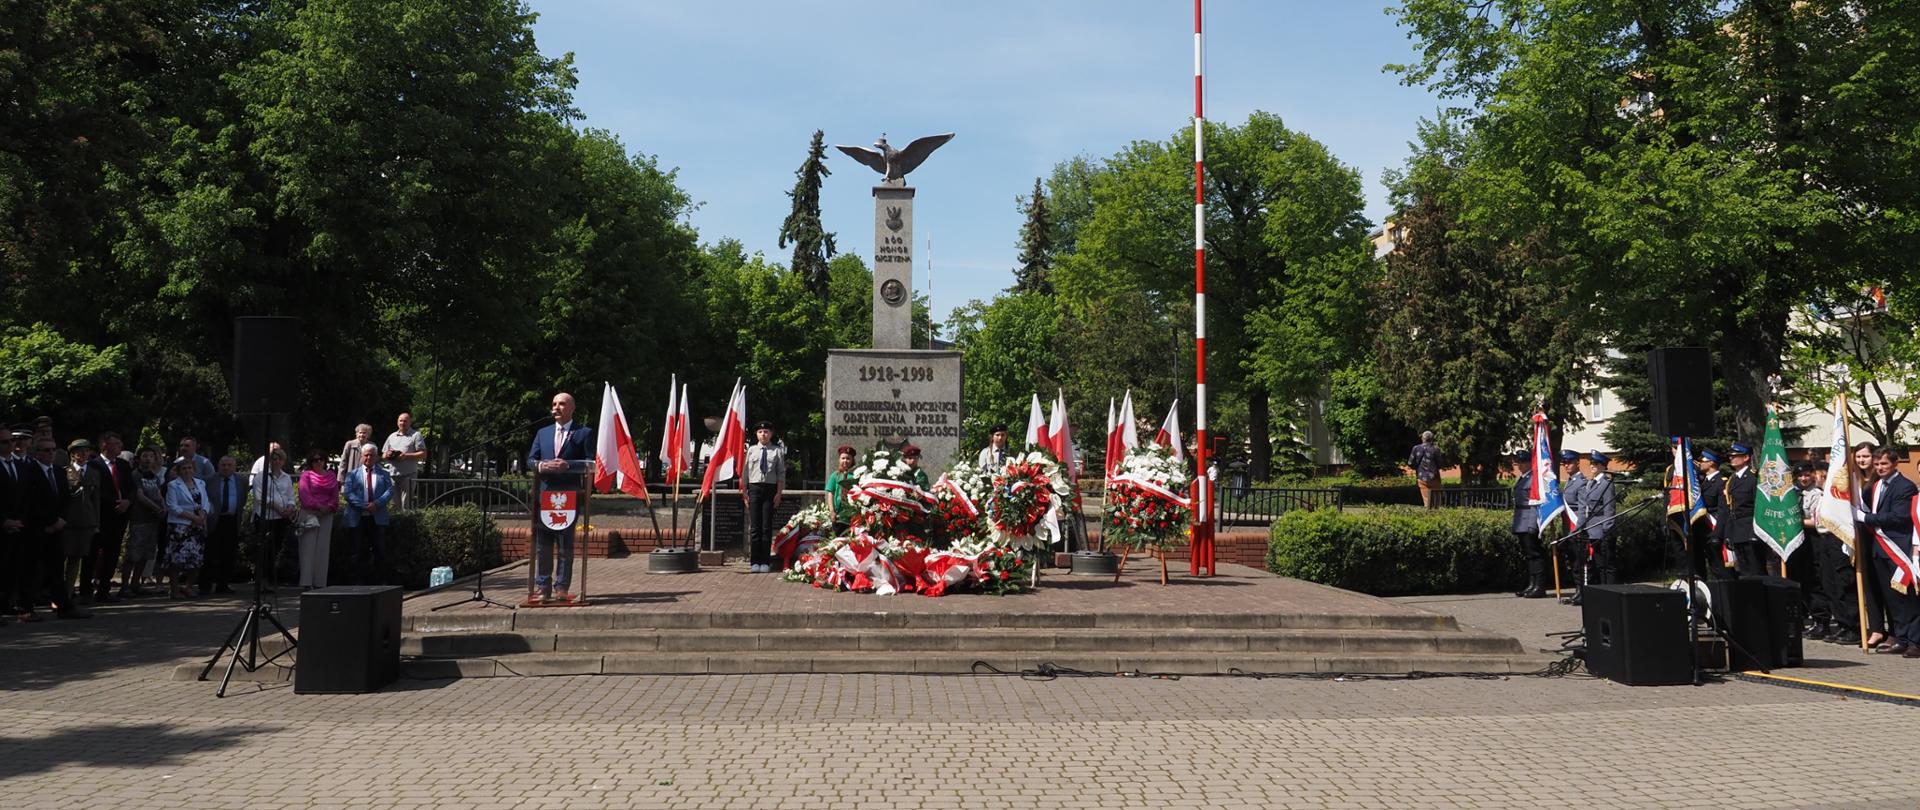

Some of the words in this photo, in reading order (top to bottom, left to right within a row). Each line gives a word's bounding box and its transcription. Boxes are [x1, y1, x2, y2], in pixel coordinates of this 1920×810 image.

[875, 254, 912, 262] OJCZYZNA
[859, 366, 934, 382] 1918-1998
[892, 389, 901, 398] W
[843, 412, 906, 424] ODZYSKANIA
[915, 414, 948, 424] PRZEZ
[874, 425, 958, 438] NIEPODLEGŁOŚCI
